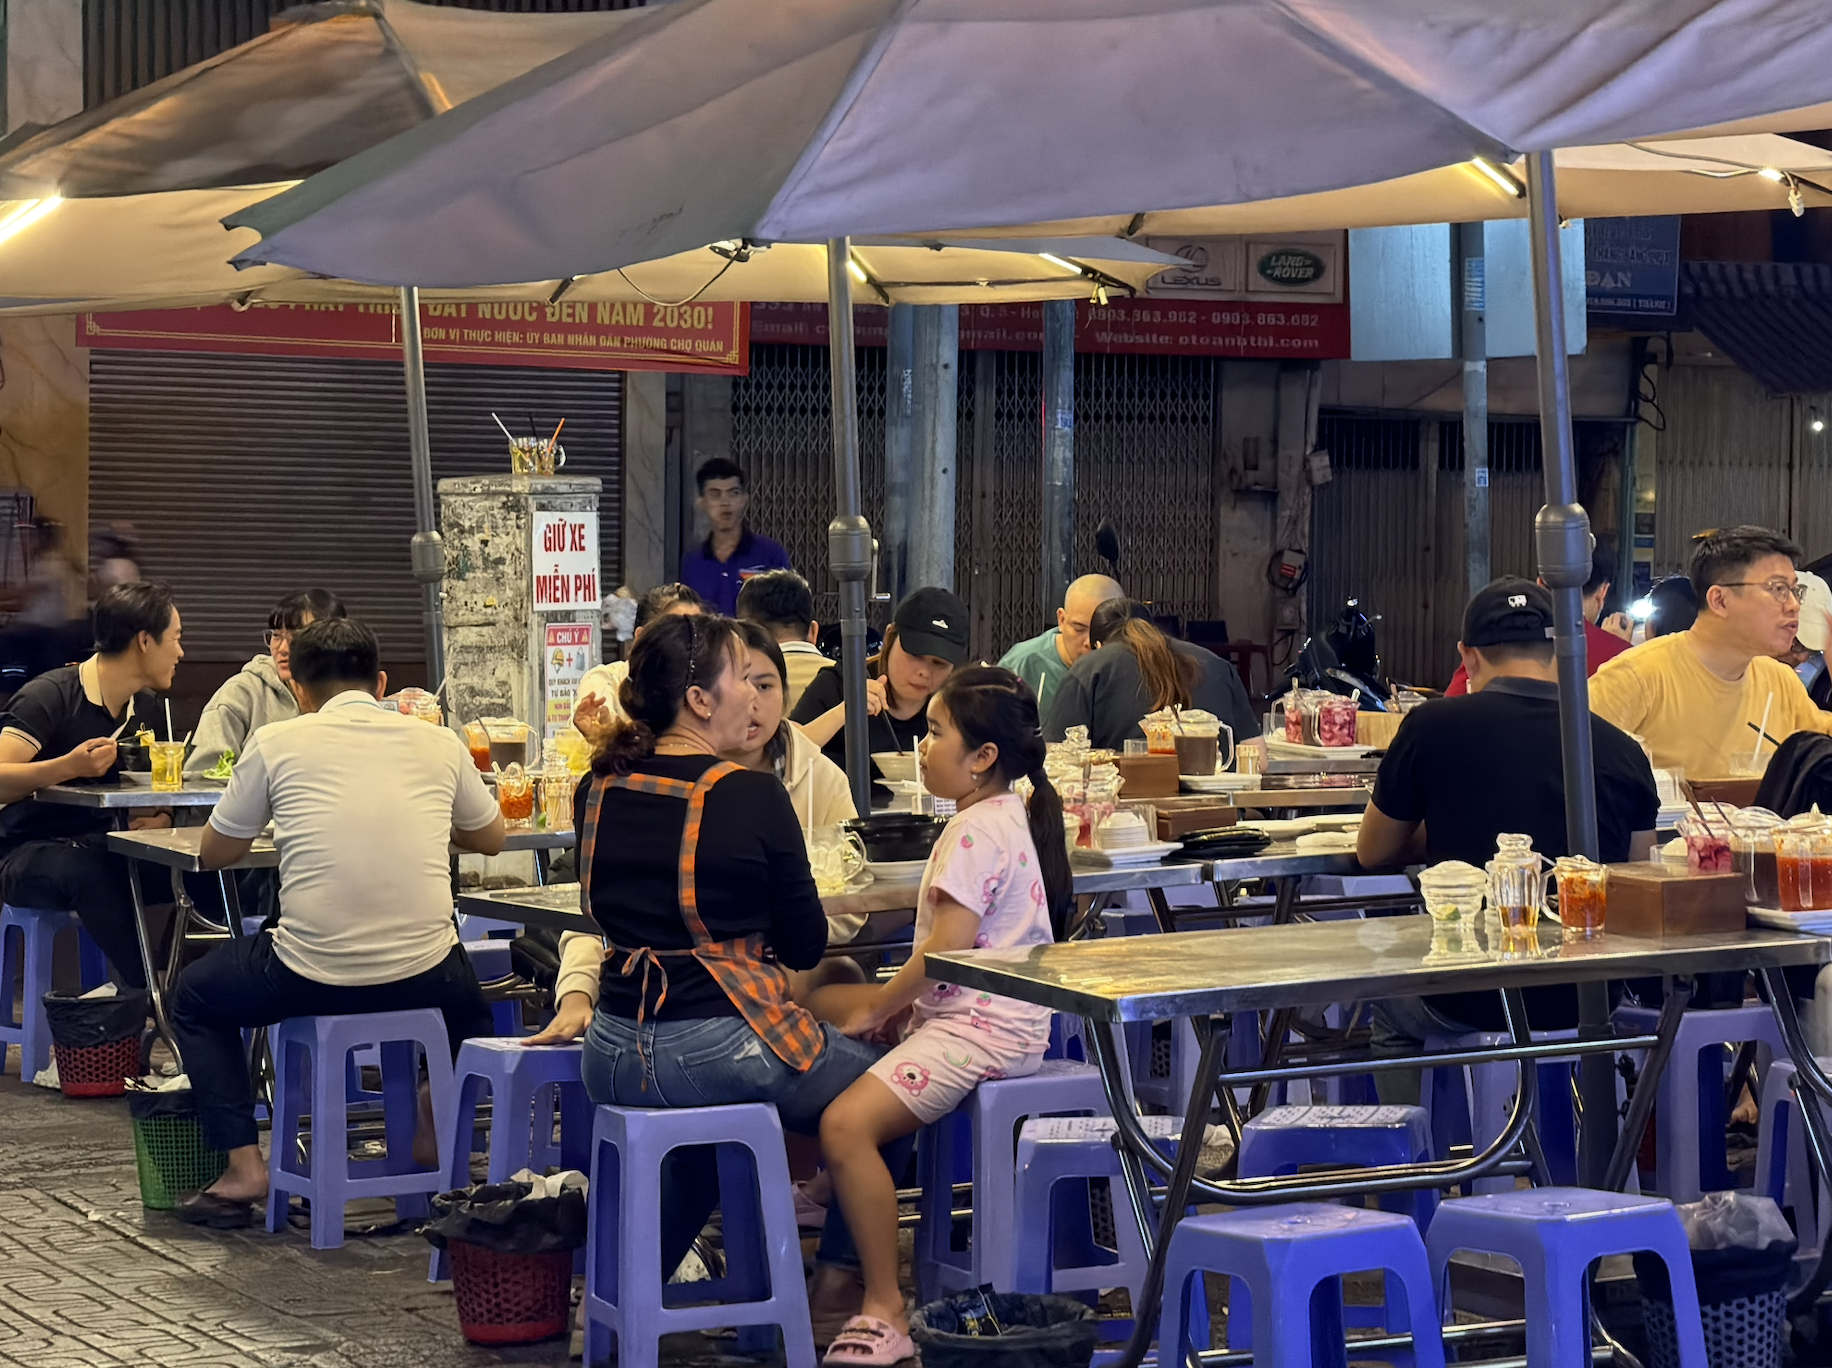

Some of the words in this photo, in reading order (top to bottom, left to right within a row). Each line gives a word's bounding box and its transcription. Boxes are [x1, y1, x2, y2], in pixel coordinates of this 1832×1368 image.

[1270, 255, 1304, 267] LAND
[1272, 266, 1315, 279] ROVER
[1161, 275, 1222, 287] LEXUS
[652, 304, 714, 330] 2030!
[423, 326, 446, 341] ĐƠN
[449, 328, 460, 343] VỊ
[463, 328, 492, 344] THỰC
[495, 329, 524, 345] HIỆN:
[543, 330, 565, 345] BAN
[567, 329, 596, 346] NHÂN
[1095, 331, 1173, 345] Website:
[543, 518, 567, 553] GIỮ
[569, 523, 586, 552] XE
[535, 563, 571, 604] MIỄN
[574, 568, 597, 603] PHÍ
[556, 628, 573, 644] CHÚ
[573, 628, 580, 643] Ý
